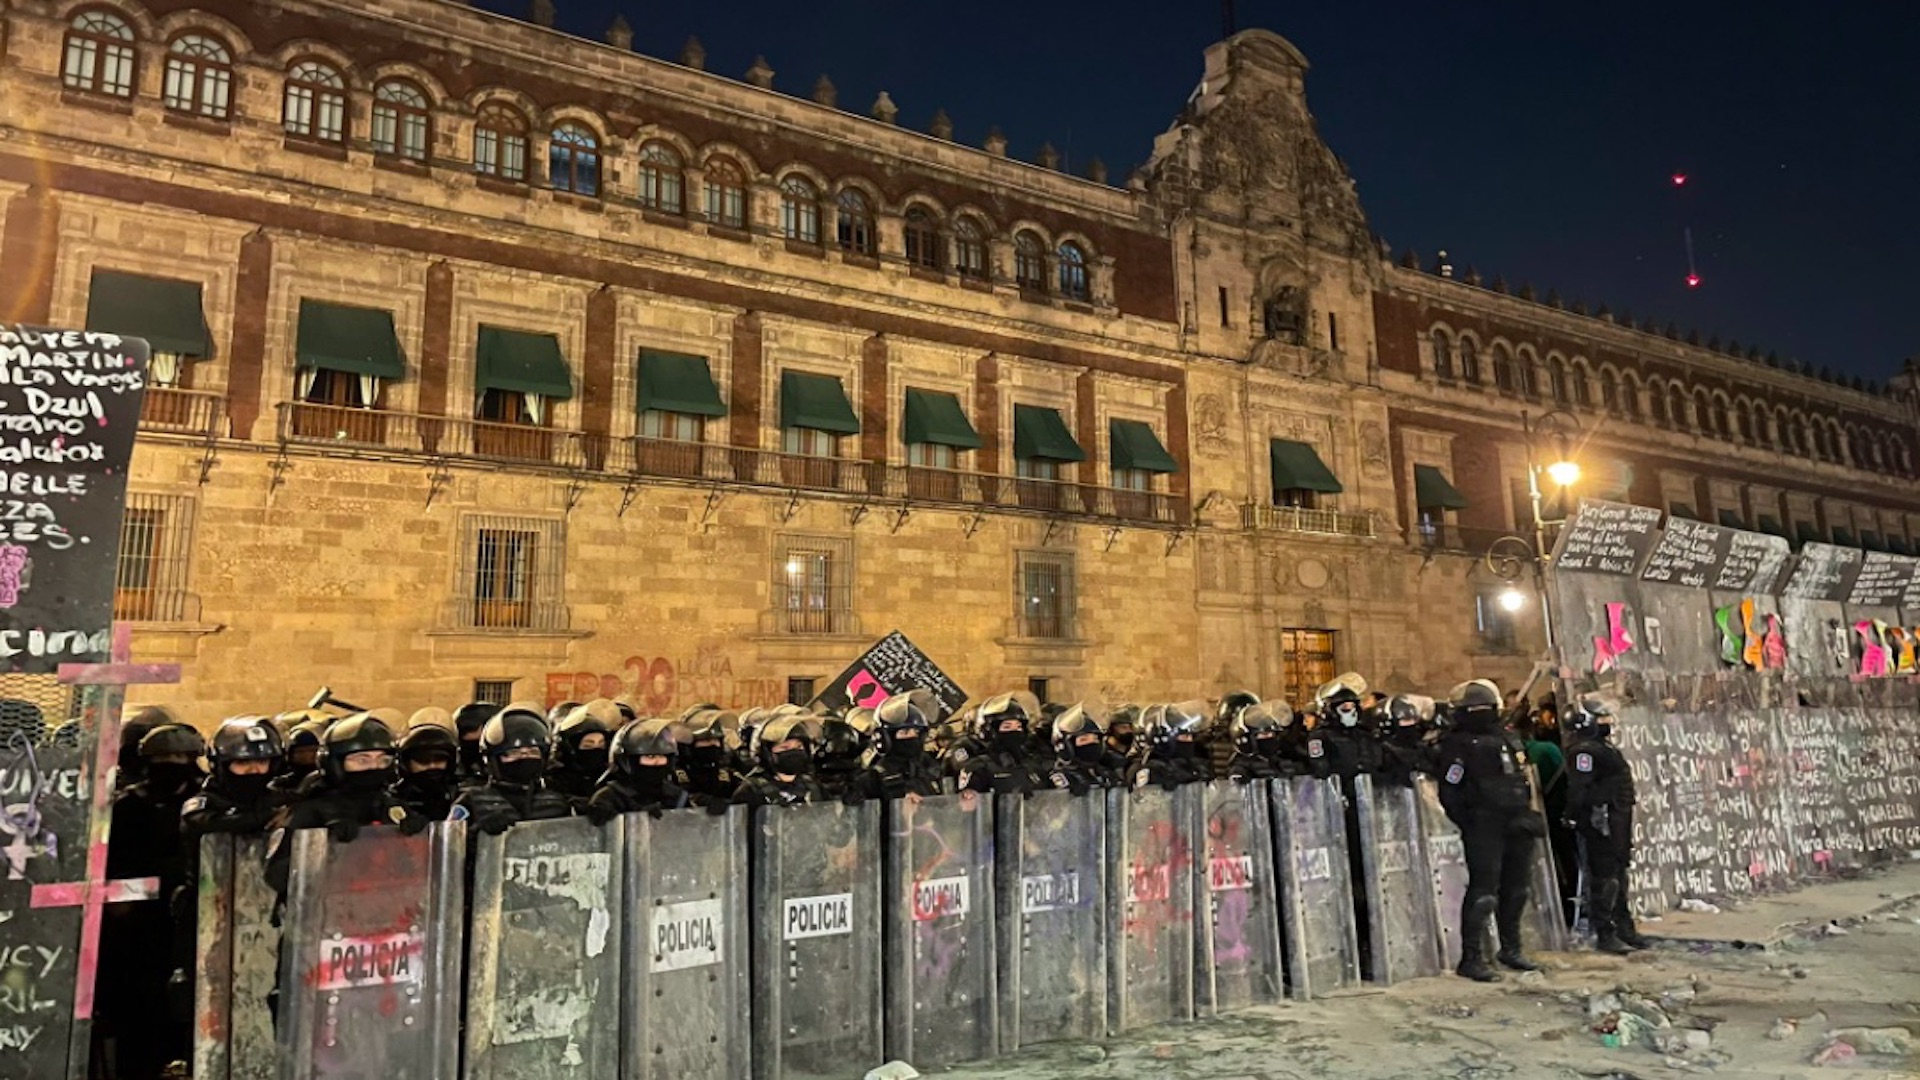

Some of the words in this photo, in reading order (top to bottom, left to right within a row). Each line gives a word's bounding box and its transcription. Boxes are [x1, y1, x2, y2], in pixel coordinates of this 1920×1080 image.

[658, 917, 715, 955] POLICIA
[788, 901, 848, 934] POLICIA
[329, 941, 410, 982] POLICIA
